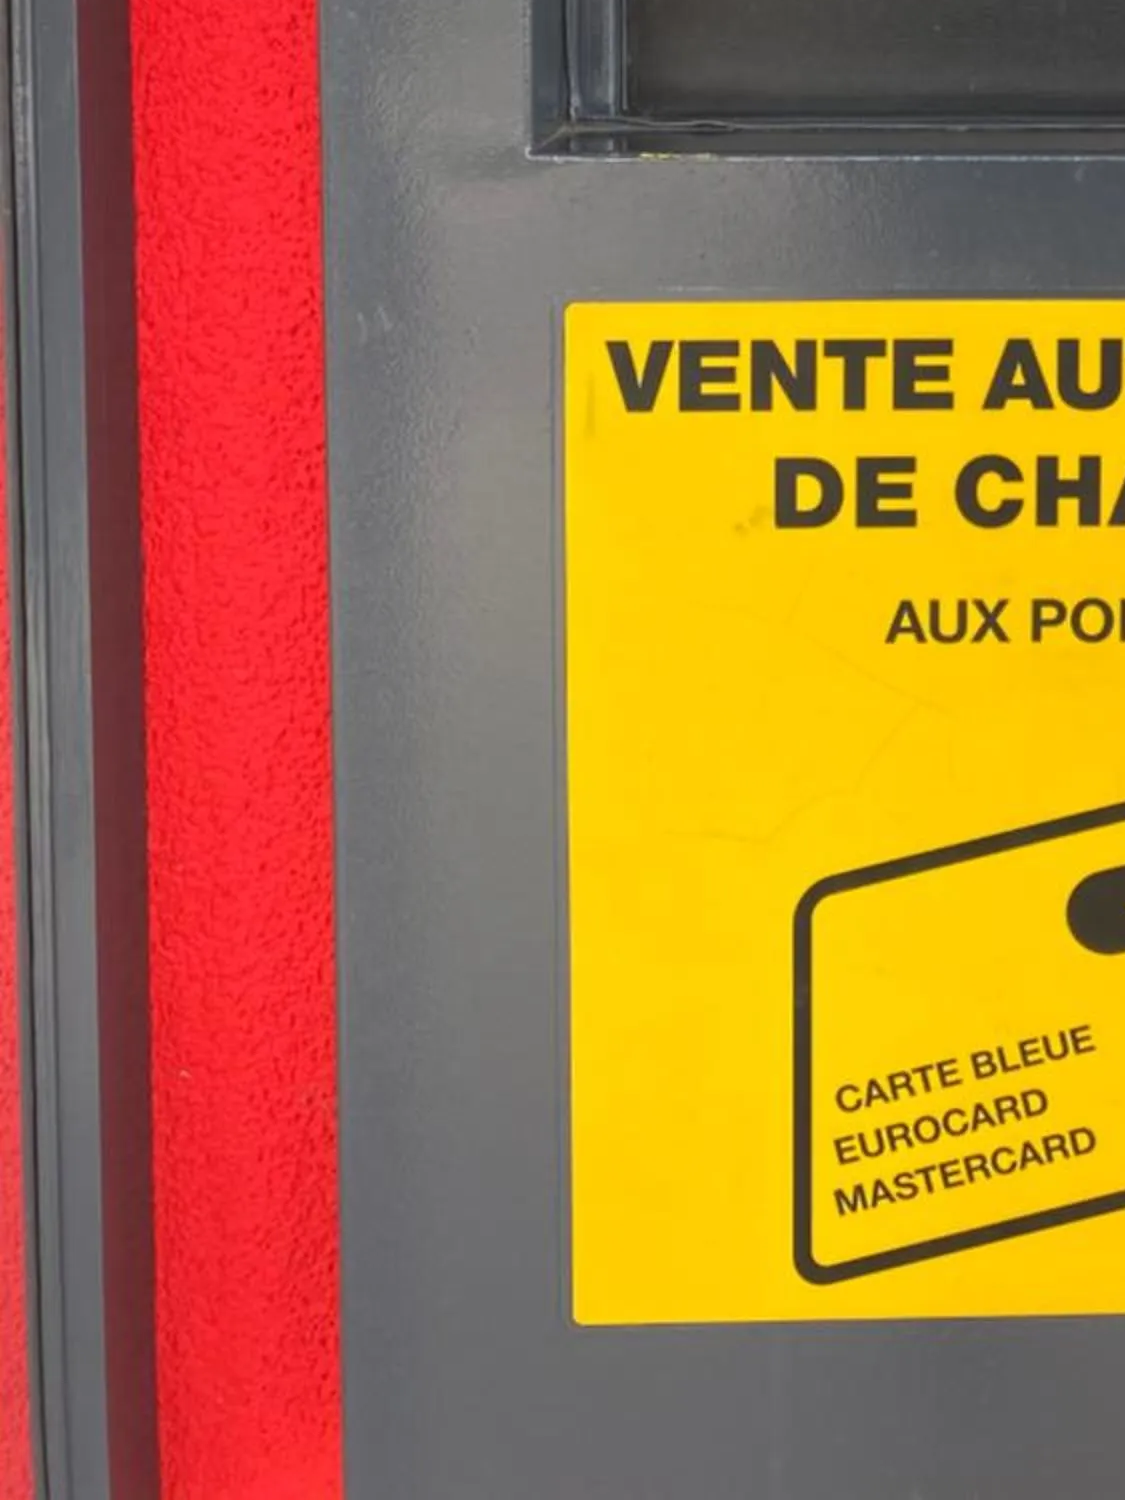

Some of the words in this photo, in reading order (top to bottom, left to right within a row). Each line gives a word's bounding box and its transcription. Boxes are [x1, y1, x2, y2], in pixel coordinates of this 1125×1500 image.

[607, 339, 953, 412] VENTE
[775, 457, 916, 529] DE
[887, 600, 1008, 643] AUX
[836, 1059, 961, 1113] CARTE
[971, 1026, 1095, 1079] BLEUE
[834, 1090, 1049, 1164] EUROCARD
[834, 1128, 1097, 1215] MASTERCARD
